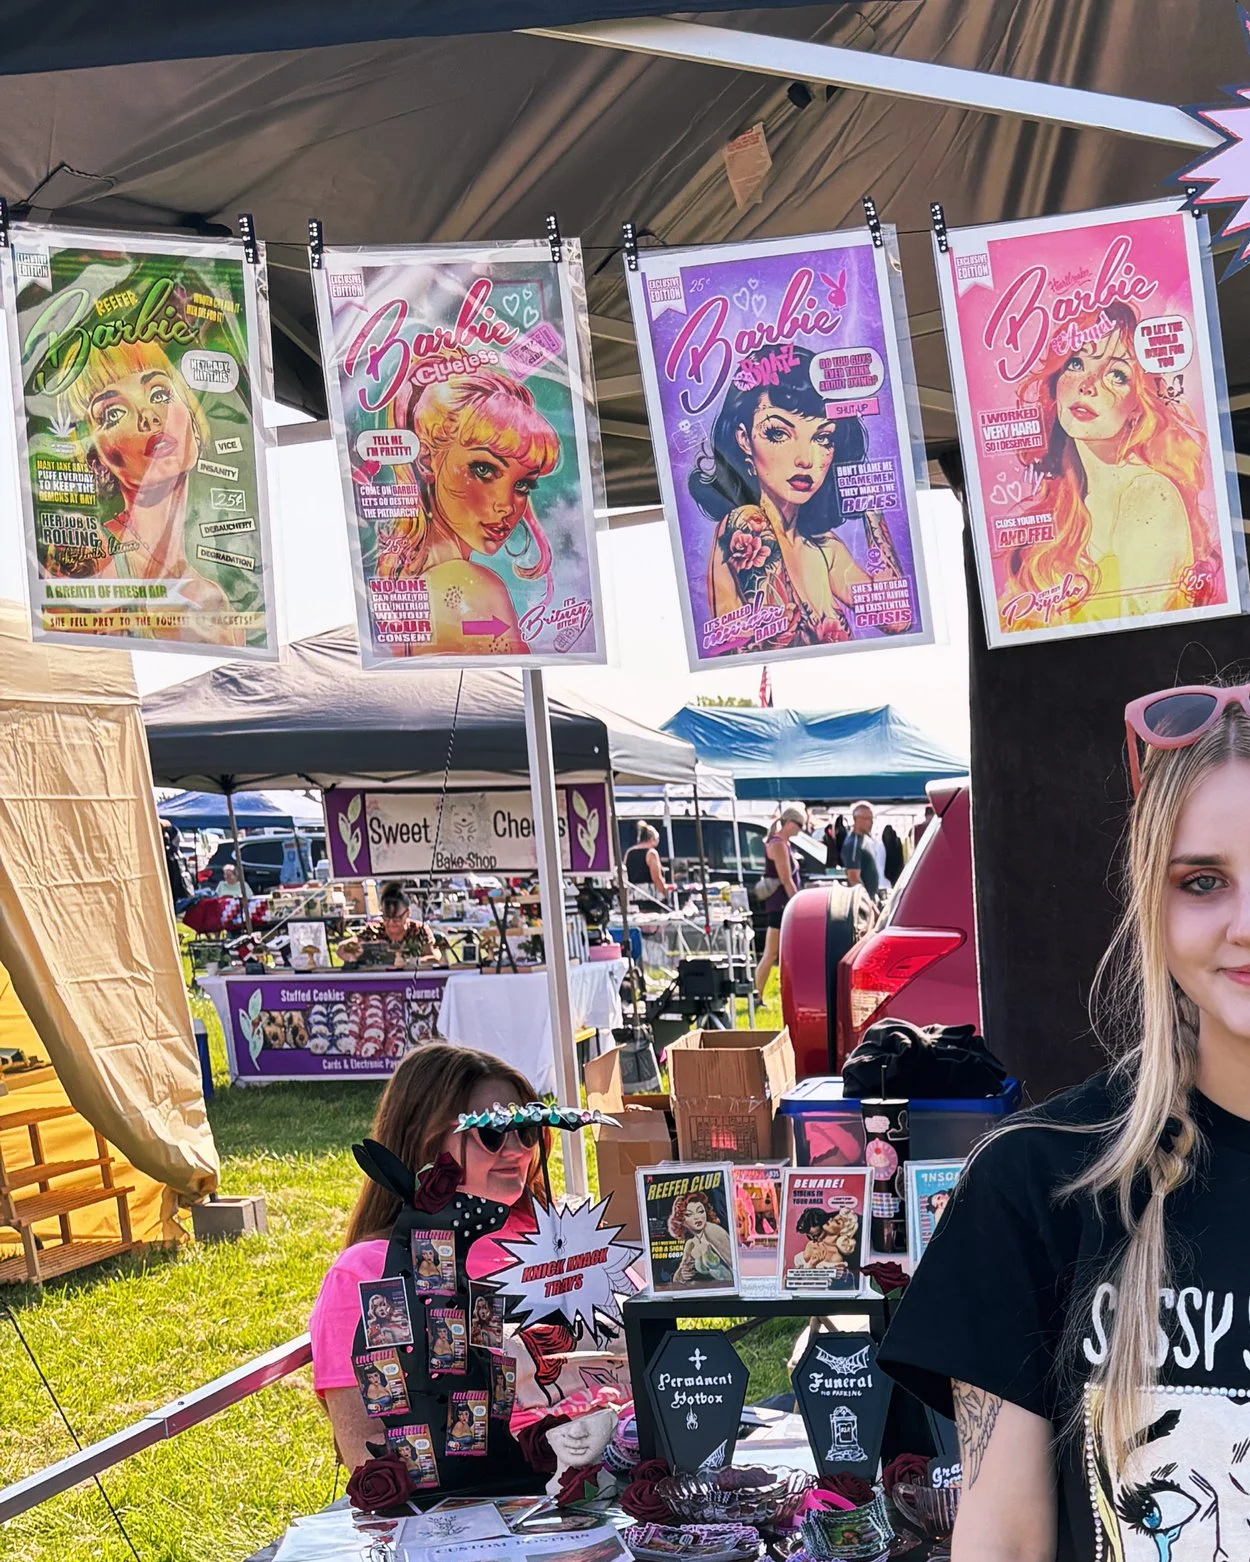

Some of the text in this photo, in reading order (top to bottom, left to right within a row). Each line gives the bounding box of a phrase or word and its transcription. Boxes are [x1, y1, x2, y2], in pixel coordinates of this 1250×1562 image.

[956, 254, 987, 266] EXCLUSIVE
[958, 264, 988, 280] EDITION
[96, 290, 138, 316] REEFER
[651, 290, 681, 302] EDITION
[983, 236, 1158, 382] Barbie
[21, 277, 198, 396] Barbie
[344, 277, 519, 412] Barbie
[665, 268, 841, 415] Barbie
[836, 404, 855, 415] SHUT
[988, 408, 1038, 424] WORKED
[982, 420, 1040, 440] VERY HARD
[218, 442, 237, 450] VICE
[373, 436, 390, 445] TELL
[985, 437, 1031, 452] SO DESERVE
[380, 447, 412, 456] PRETTY!
[200, 464, 237, 478] INSANITY
[857, 462, 881, 474] BLAME
[838, 473, 894, 487] BLAME MEN
[839, 486, 858, 497] THEY
[390, 497, 418, 506] DESTROY
[843, 494, 897, 513] RULES
[44, 529, 98, 547] ROLLING
[999, 525, 1054, 547] AND FEEL
[200, 549, 252, 567] DEGRADATION
[371, 580, 427, 591] NO ONE
[721, 603, 751, 624] CALLED
[867, 600, 910, 612] EXISTENTIAL
[856, 609, 911, 627] CRISIS
[378, 620, 431, 633] YOUR
[755, 618, 787, 643] BABY!
[378, 633, 432, 643] CONSENT
[369, 810, 566, 844] Sweet Ches
[436, 852, 497, 869] Bake Shop
[281, 989, 345, 1002] Stuffed Cookies
[406, 987, 439, 1000] Gourmet
[322, 1059, 383, 1069] Cards Electronic
[647, 1172, 721, 1200] REEFER CLUB
[793, 1179, 845, 1188] BEWARE!
[521, 1246, 609, 1284] KNICK KNACK
[544, 1274, 584, 1298] TRAYS
[1083, 1282, 1233, 1371] SSSY
[657, 1373, 732, 1391] Permanent
[808, 1373, 873, 1392] Funeral
[670, 1390, 723, 1408] Hotbox
[436, 1542, 507, 1554] CUSTOM
